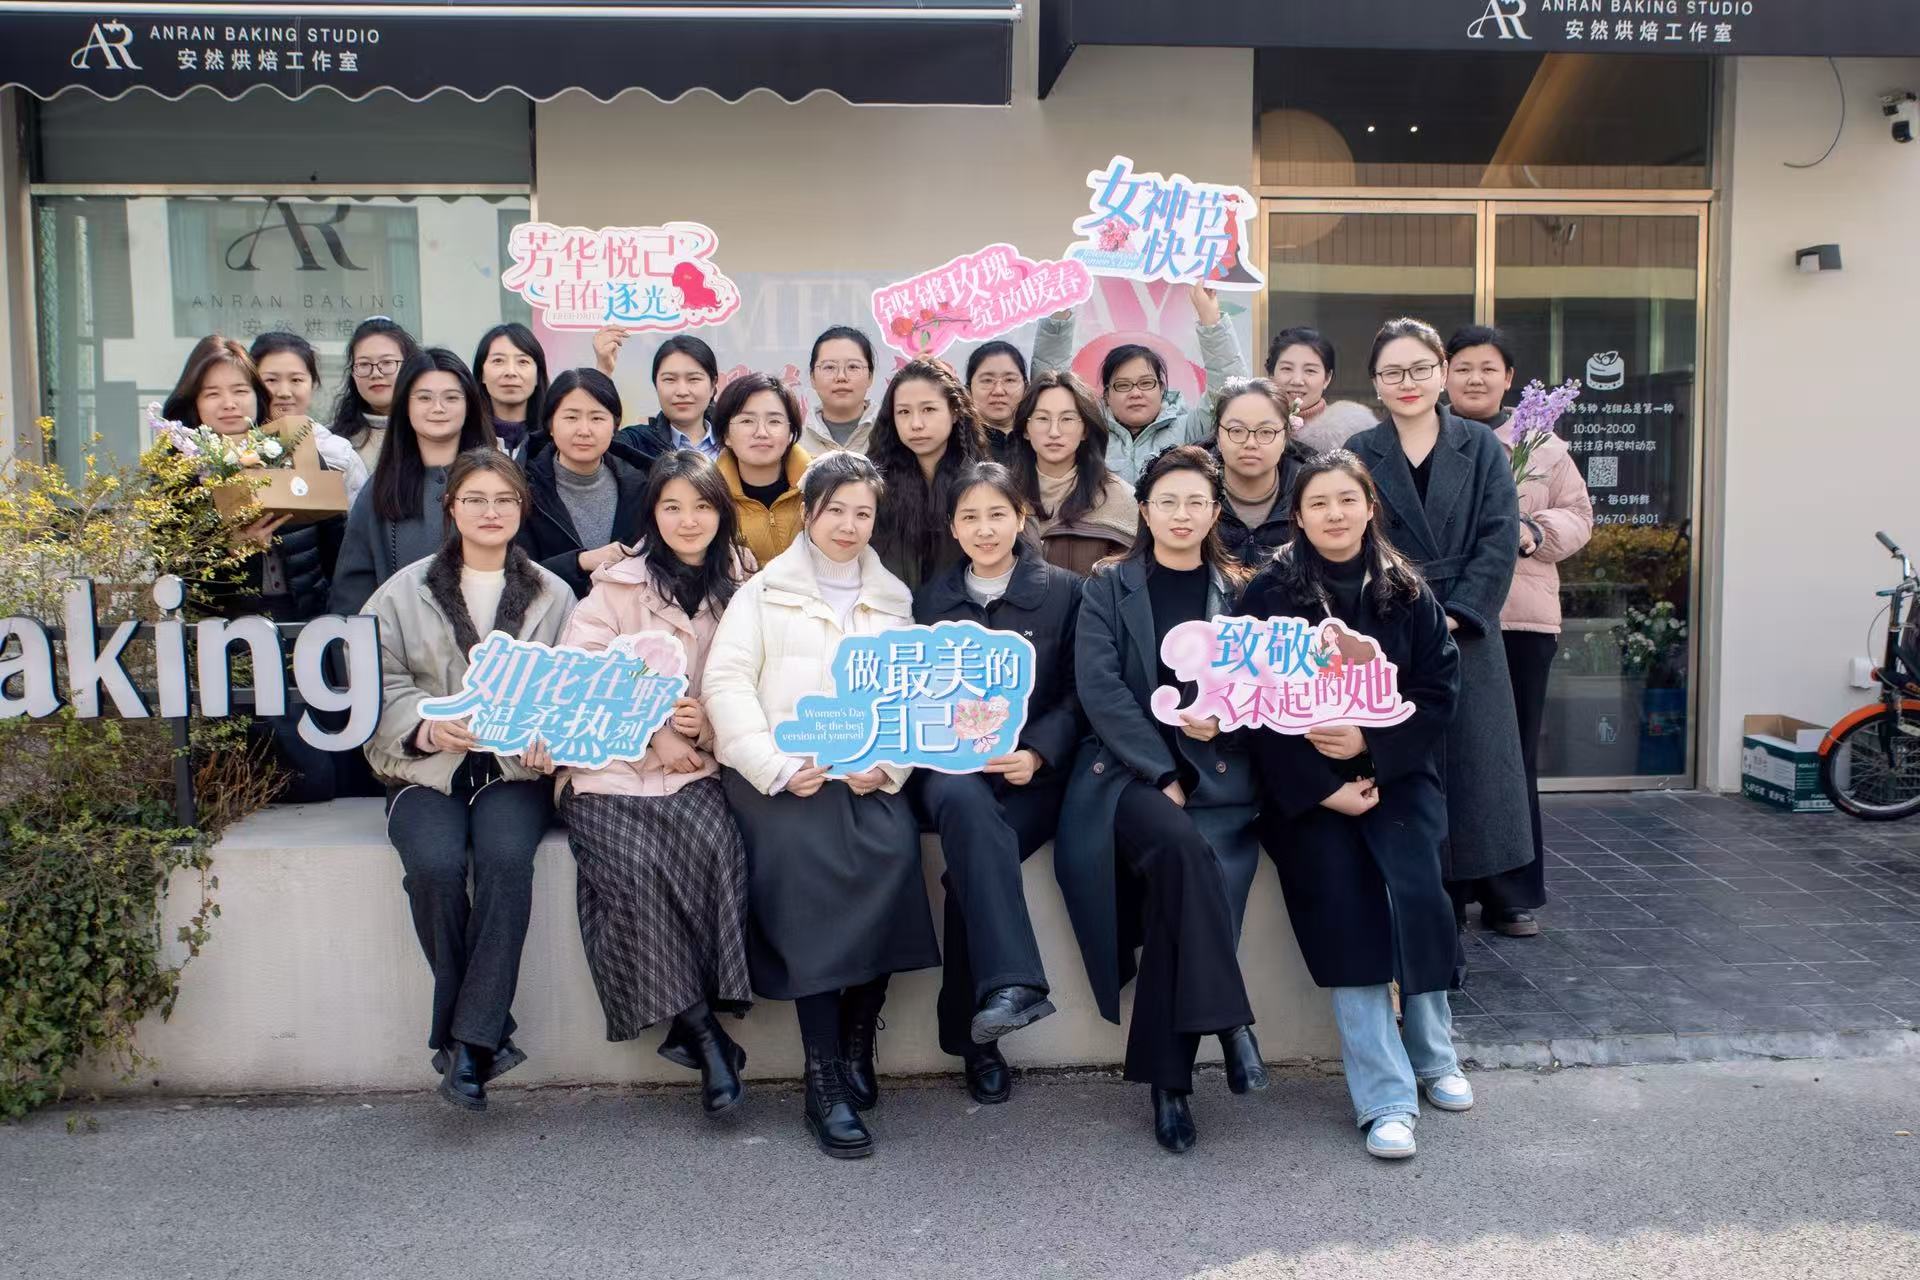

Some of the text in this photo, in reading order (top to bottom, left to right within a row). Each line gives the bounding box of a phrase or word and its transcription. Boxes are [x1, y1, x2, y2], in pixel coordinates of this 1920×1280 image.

[1565, 19, 1733, 43] 安然烘焙工作室
[1610, 0, 1678, 14] BAKING
[1687, 1, 1753, 15] STUDIO
[150, 25, 380, 44] ANRAN BAKING STUDIO
[177, 47, 359, 72] 安然烘焙工作室
[1081, 163, 1224, 236] 女神节
[515, 230, 677, 281] 芳华悦己
[1141, 227, 1233, 281] 快乐
[192, 294, 406, 309] ANRAN BAKING
[554, 279, 681, 322] 自在逐光
[879, 250, 1015, 326] 铿锵玫瑰
[968, 265, 1082, 331] 绽放暖春
[844, 636, 1021, 700] 做最美的
[1210, 618, 1317, 678] 致敬
[470, 638, 677, 722] 如花在野
[1205, 657, 1397, 727] 了不起的她
[474, 702, 645, 758] 温柔热烈
[782, 729, 864, 743] version of yourself
[804, 707, 864, 720] Women's Day
[815, 720, 864, 731] Be the best
[831, 693, 960, 764] 自己
